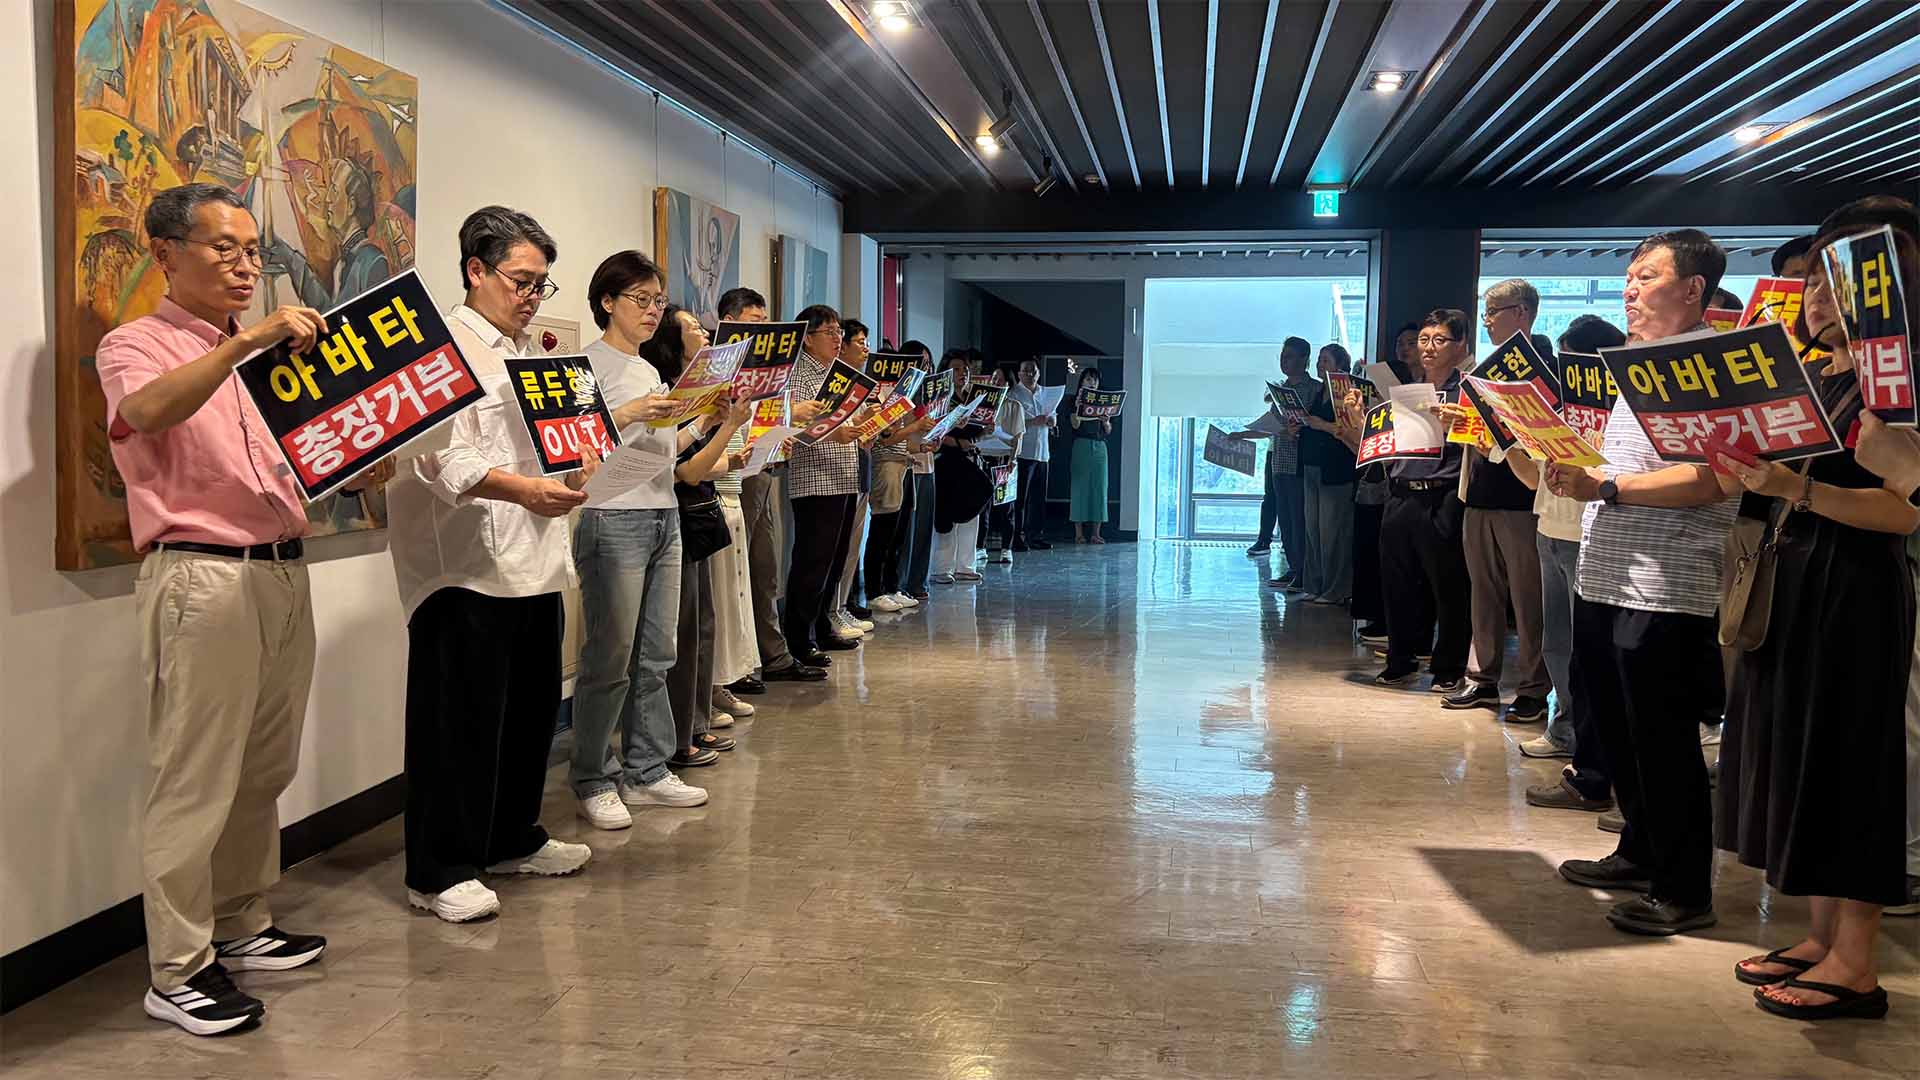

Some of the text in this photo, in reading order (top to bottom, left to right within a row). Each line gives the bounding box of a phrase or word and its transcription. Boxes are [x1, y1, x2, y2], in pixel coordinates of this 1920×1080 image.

[270, 296, 424, 402] 아바타
[1628, 342, 1778, 402] 아바타
[731, 367, 789, 399] 장거부
[293, 352, 463, 475] 총장거부
[543, 418, 601, 457] OUT
[1647, 401, 1816, 454] 총장거부
[1363, 432, 1396, 459] 총장
